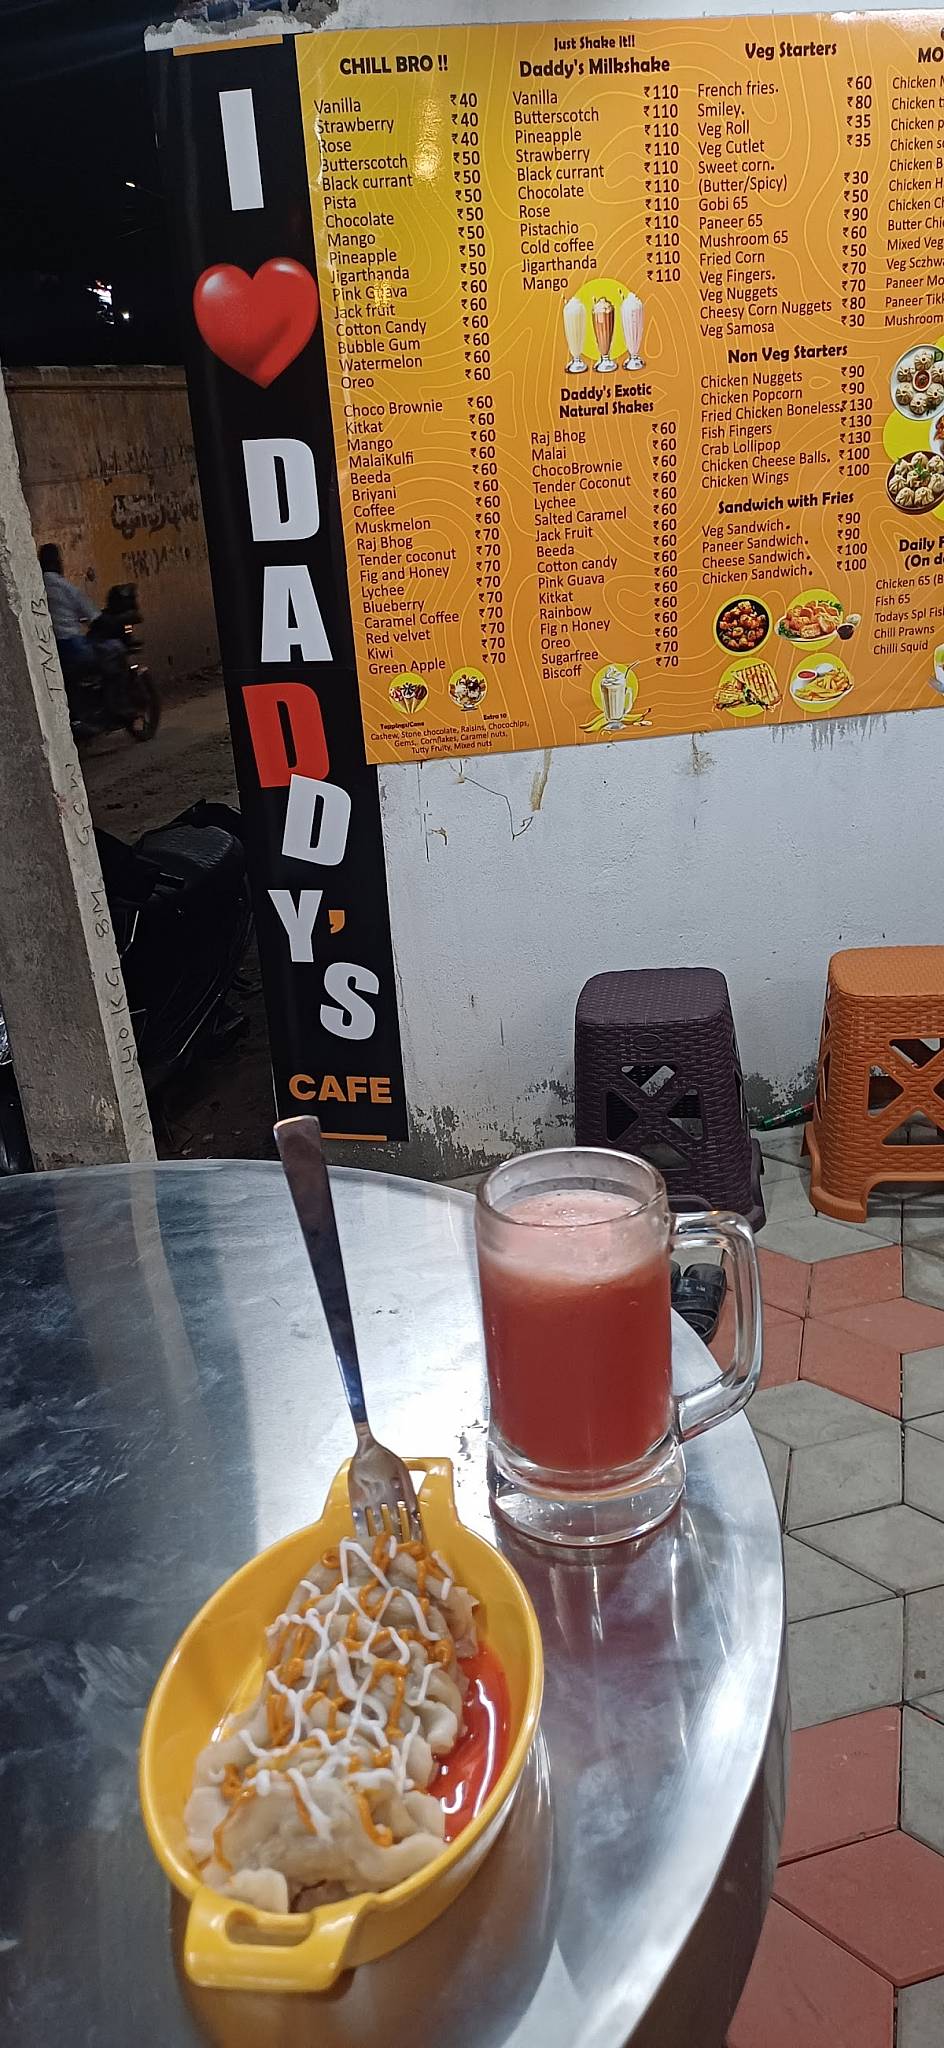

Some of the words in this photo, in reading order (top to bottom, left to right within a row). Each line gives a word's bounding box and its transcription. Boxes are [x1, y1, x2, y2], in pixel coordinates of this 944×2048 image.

[554, 37, 576, 52] Just
[580, 35, 616, 50] Shake
[745, 42, 775, 61] Veg
[779, 41, 837, 58] Starters
[340, 56, 392, 75] CHILL
[396, 54, 433, 72] BRO
[520, 59, 584, 79] Daddy's
[588, 56, 670, 75] Milkshake
[698, 81, 742, 98] French
[892, 75, 936, 90] Chicken
[512, 88, 558, 105] Vanilla
[314, 97, 361, 114] Vanilla
[317, 116, 394, 134] Strawberry
[697, 122, 722, 139] Veg
[726, 119, 750, 136] Roll
[515, 126, 582, 146] Pineapple
[218, 88, 264, 211] I
[320, 139, 352, 153] Rose
[321, 153, 408, 172] Butterscotch
[698, 160, 738, 174] Sweet
[322, 174, 359, 192] Black
[362, 174, 413, 189] currant
[698, 174, 787, 196] (Butter/Spicy)
[324, 196, 356, 210] Pista
[698, 196, 729, 212] Gobi
[733, 196, 748, 210] 65
[326, 211, 394, 228] Chocolate
[888, 219, 922, 231] Butter
[520, 220, 579, 237] Pistachio
[327, 233, 376, 248] Mango
[521, 239, 550, 254] Cold
[554, 237, 594, 253] coffee
[700, 232, 769, 248] Mushroom
[773, 230, 788, 244] 65
[887, 236, 921, 251] Mixed
[330, 247, 397, 266] Pineapple
[700, 250, 731, 266] Fried
[735, 250, 765, 264] Corn
[330, 265, 410, 286] Jigarthanda
[332, 286, 362, 302] Pink
[334, 304, 363, 320] Jack
[365, 303, 396, 317] fruit
[700, 305, 745, 320] Cheesy
[748, 303, 777, 316] Corn
[782, 300, 832, 316] Nuggets
[336, 323, 382, 337] Cotton
[385, 318, 427, 335] Candy
[726, 322, 774, 335] Samosa
[885, 314, 943, 326] Mushroom
[338, 338, 385, 354] Bubble
[388, 338, 420, 351] Gum
[728, 349, 758, 364] Non
[762, 346, 790, 362] Veg
[794, 344, 848, 360] Starters
[338, 354, 422, 372] Watermelon
[341, 376, 374, 389] Oreo
[700, 373, 748, 388] Chicken
[752, 370, 802, 387] Nuggets
[561, 385, 611, 402] Daddy's
[614, 382, 652, 398] Exotic
[752, 389, 802, 404] Popcorn
[344, 403, 385, 417] Choco
[389, 399, 443, 414] Brownie
[559, 402, 608, 418] Natural
[612, 400, 654, 415] Shakes
[345, 420, 384, 435] Kitkat
[702, 425, 725, 440] Fish
[729, 424, 772, 439] Fingers
[347, 438, 393, 452] Mango
[531, 431, 550, 446] Raj
[554, 429, 586, 444] Bhog
[532, 446, 566, 462] Malai
[701, 442, 729, 456] Crab
[733, 439, 781, 454] Lollipop
[349, 451, 414, 469] MalaiKulfi
[532, 459, 622, 478] ChocoBrownie
[752, 455, 796, 468] Cheese
[350, 470, 391, 485] Beeda
[579, 475, 631, 490] Coconut
[752, 472, 789, 486] Wings
[352, 486, 396, 503] Briyani
[718, 496, 784, 514] Sandwich
[787, 493, 818, 508] with
[822, 491, 854, 506] Fries
[354, 503, 395, 518] Coffee
[534, 510, 572, 526] Salted
[576, 506, 626, 522] Caramel
[355, 517, 431, 534] Muskmelon
[564, 526, 593, 540] Fruit
[702, 540, 744, 554] Paneer
[899, 537, 935, 552] Daily
[357, 552, 402, 566] Tender
[406, 548, 456, 563] coconut
[537, 560, 578, 574] Cotton
[582, 554, 618, 570] candy
[702, 556, 745, 569] Cheese
[360, 570, 378, 584] Fig
[382, 566, 405, 581] and
[409, 566, 449, 579] Honey
[538, 575, 564, 589] Pink
[567, 574, 604, 586] Guava
[361, 584, 404, 600] Lychee
[876, 595, 895, 607] Fish
[898, 593, 910, 604] 65
[363, 599, 424, 614] Blueberry
[540, 605, 592, 620] Rainbow
[364, 613, 416, 629] Caramel
[420, 610, 459, 624] Coffee
[874, 611, 909, 623] Todays
[366, 631, 390, 644] Red
[392, 629, 431, 642] velvet
[898, 626, 935, 637] Prawns
[368, 646, 393, 660] Kiwi
[873, 643, 898, 655] Chilli
[900, 639, 928, 654] Squid
[368, 663, 408, 674] Green
[410, 657, 446, 674] Apple
[542, 649, 598, 666] Sugarfree
[542, 664, 582, 680] Biscoff
[288, 1073, 393, 1104] CAFE
